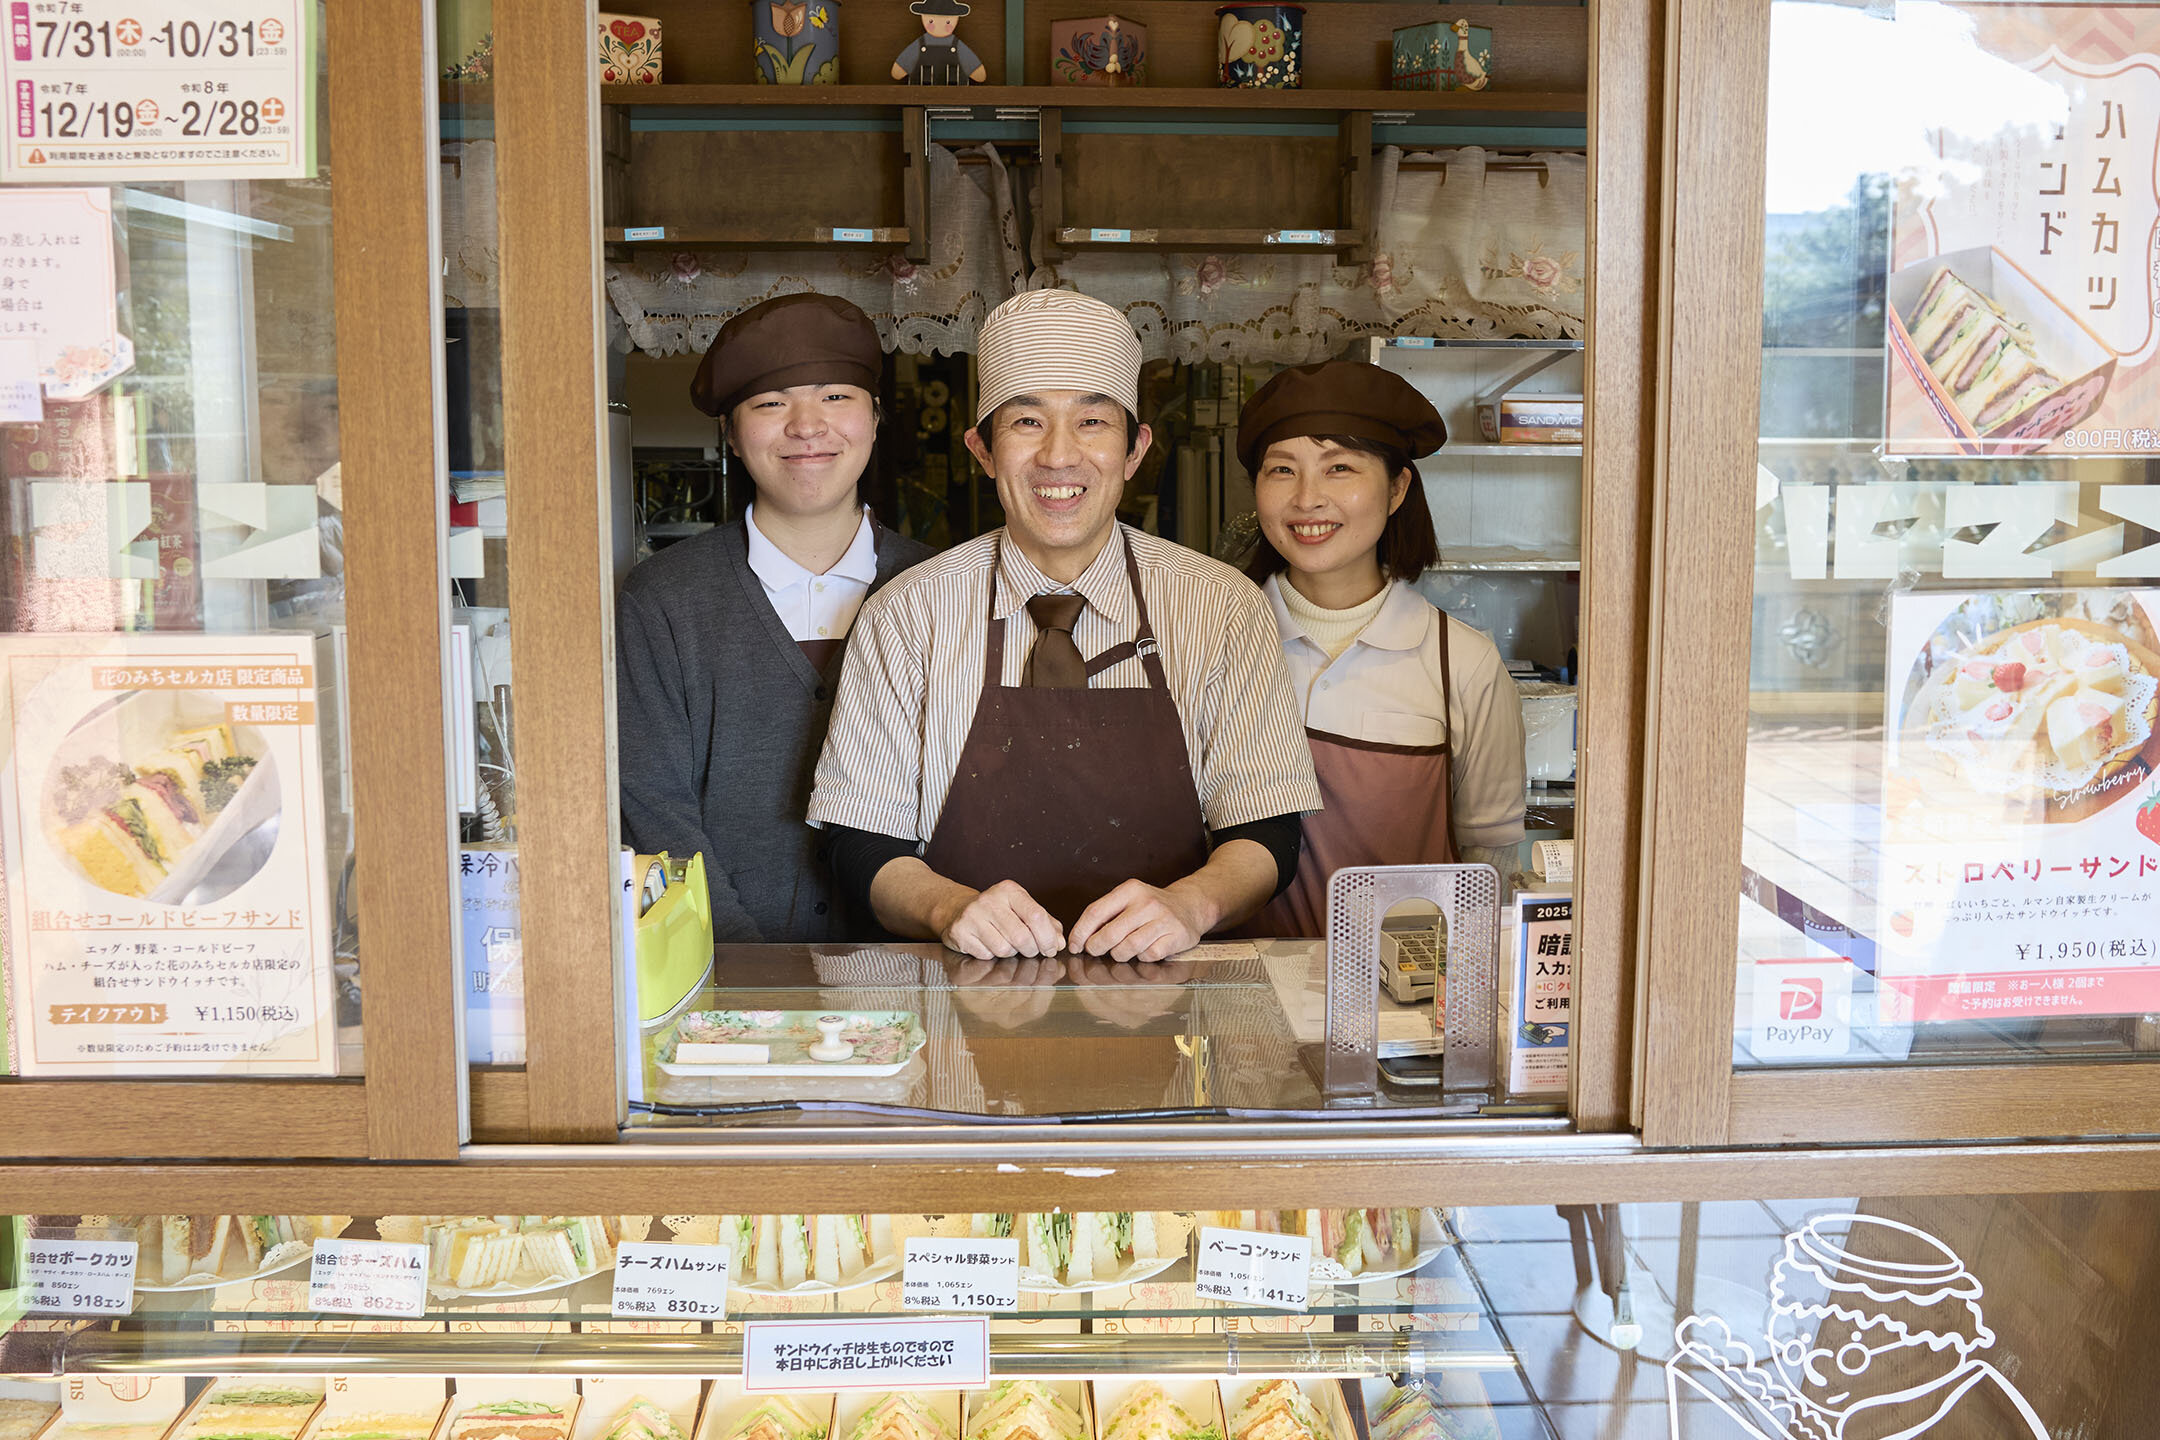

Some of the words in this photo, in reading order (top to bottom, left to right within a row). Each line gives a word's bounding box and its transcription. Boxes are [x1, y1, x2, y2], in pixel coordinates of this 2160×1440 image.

[36, 21, 111, 58] 7/31
[117, 20, 141, 43] 木
[615, 26, 639, 38] TEA
[41, 82, 88, 95] 令和7年
[181, 81, 229, 95] 令和8年
[41, 102, 134, 138] 12/19
[264, 99, 283, 121] 土
[2039, 124, 2068, 255] ンド
[2088, 101, 2126, 310] ハムカツ
[100, 668, 233, 687] 花のみちセルカ店
[237, 668, 304, 685] 限定商品
[232, 704, 299, 722] 数量限定
[2053, 765, 2146, 810] Strawberry
[1905, 854, 2159, 884] ストロベリーサンド
[32, 908, 304, 929] 組合せコールドビーフサンド
[1537, 906, 1571, 918] 2025
[1946, 907, 2119, 922] っぷり入ったサンドウイッチです。
[85, 943, 257, 955] エッグ・野菜・コールドビーフ
[2016, 938, 2156, 961] ¥1,950(税込)
[43, 958, 301, 972] ハム・チーズが入った花のみちセルカ店限定の
[94, 976, 247, 988] 組合せサンドウイッチです。
[1543, 982, 1553, 991] IC
[1948, 981, 1996, 994] 数量限定
[2068, 976, 2105, 989] 2個まで
[1535, 997, 1570, 1010] ご利用
[1961, 996, 2083, 1011] ご予約はお受けできません。
[60, 1005, 163, 1023] テイクアウト
[195, 1005, 300, 1023] ¥1,150(税込)
[1766, 1024, 1834, 1044] PayPay
[907, 1252, 1016, 1265] スペシャル野菜サンド
[1208, 1240, 1301, 1262] ベーコンサンド
[314, 1253, 422, 1270] 組合せチーズハム
[619, 1255, 727, 1272] チーズハムサンド
[1198, 1269, 1222, 1278] 本体価格
[51, 1281, 80, 1290] 850エン
[614, 1286, 639, 1294] 本体価格
[647, 1286, 675, 1295] 769エン
[937, 1281, 974, 1289] 1,065エン
[23, 1295, 61, 1307] 8%税込
[73, 1294, 125, 1308] 918エン
[904, 1295, 941, 1306] 8%税込
[952, 1294, 1016, 1307] 1,150エン
[1196, 1283, 1232, 1296] 8%税込
[1243, 1286, 1306, 1304] 1,141エン
[314, 1297, 353, 1309] 8%税込
[363, 1296, 416, 1311] 862エン
[617, 1301, 657, 1312] 8%税込
[667, 1299, 720, 1314] 830エン
[774, 1340, 954, 1356] サンドウイッチは生ものですので
[775, 1355, 952, 1371] 本日中にお召し上がりください
